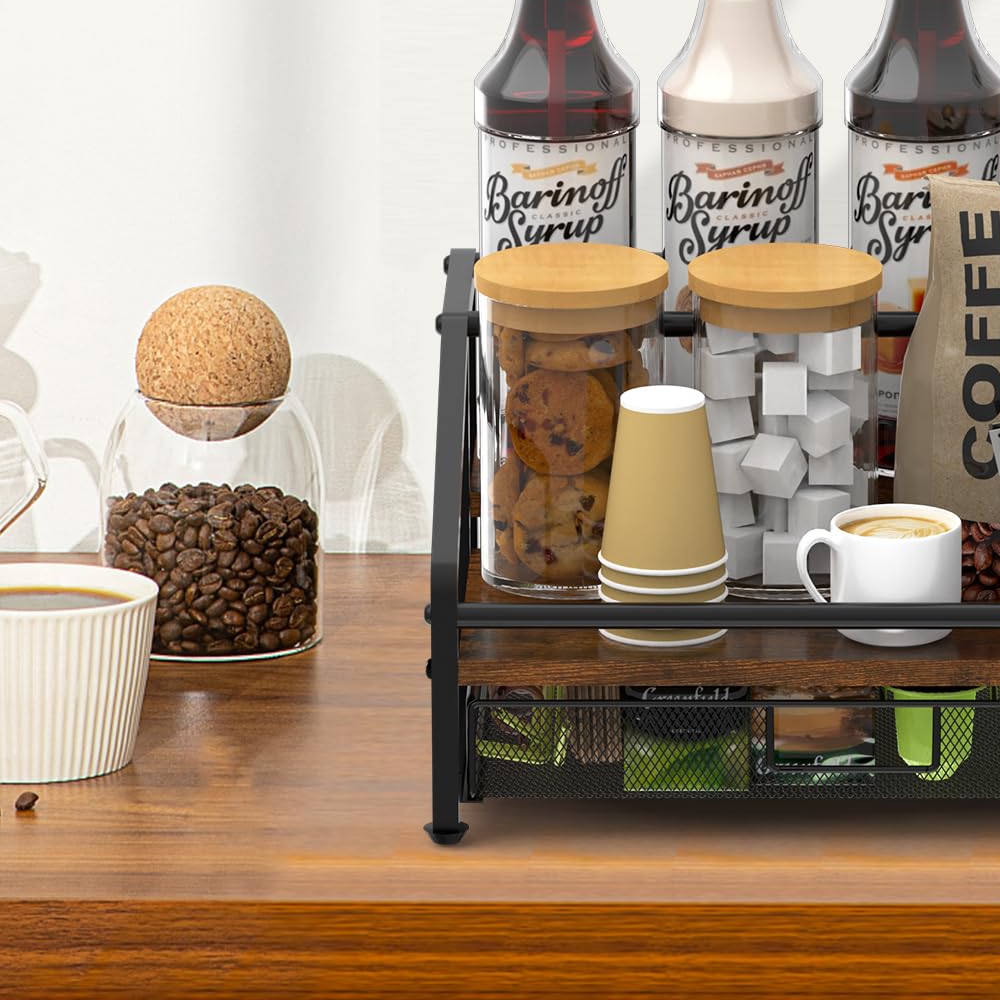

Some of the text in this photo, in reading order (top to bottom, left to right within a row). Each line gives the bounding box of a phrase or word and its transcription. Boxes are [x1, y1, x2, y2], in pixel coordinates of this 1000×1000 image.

[484, 134, 627, 154] PROFESSIONAL
[667, 133, 813, 153] PROFESSIONAL
[855, 134, 1000, 155] PROFESSIONAL
[484, 153, 627, 224] Barinoff
[666, 152, 813, 224] Barinoff
[532, 209, 582, 220] CLASSIC
[716, 210, 769, 221] CLASSIC
[497, 209, 604, 250] Syrup
[679, 210, 791, 265] Syrup
